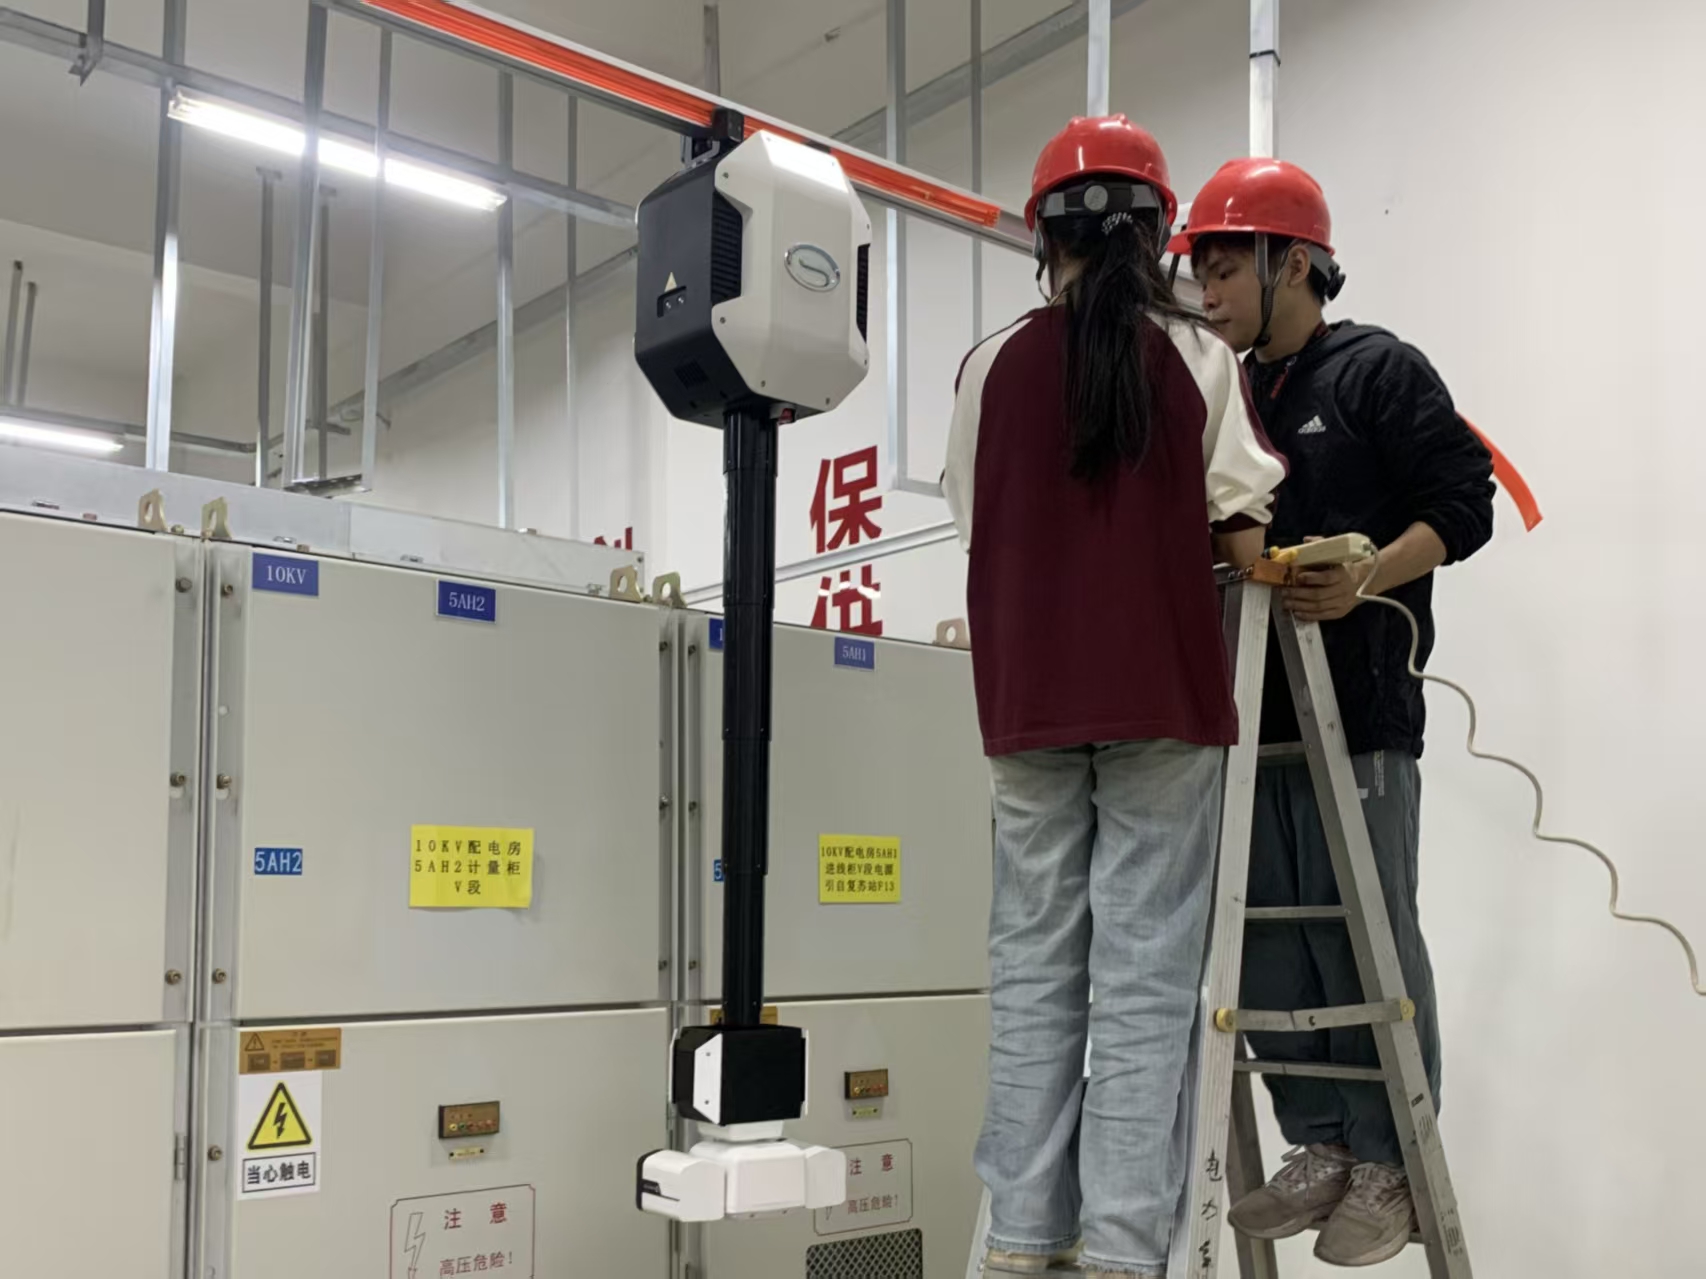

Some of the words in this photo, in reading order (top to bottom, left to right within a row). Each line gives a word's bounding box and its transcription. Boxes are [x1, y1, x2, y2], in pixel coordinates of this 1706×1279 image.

[265, 564, 307, 586] 10KV
[448, 591, 486, 613] 5AH2
[842, 645, 866, 662] 5AH1
[255, 851, 303, 873] 5AH2
[454, 879, 482, 895] V段
[247, 1159, 311, 1186] 当心触电
